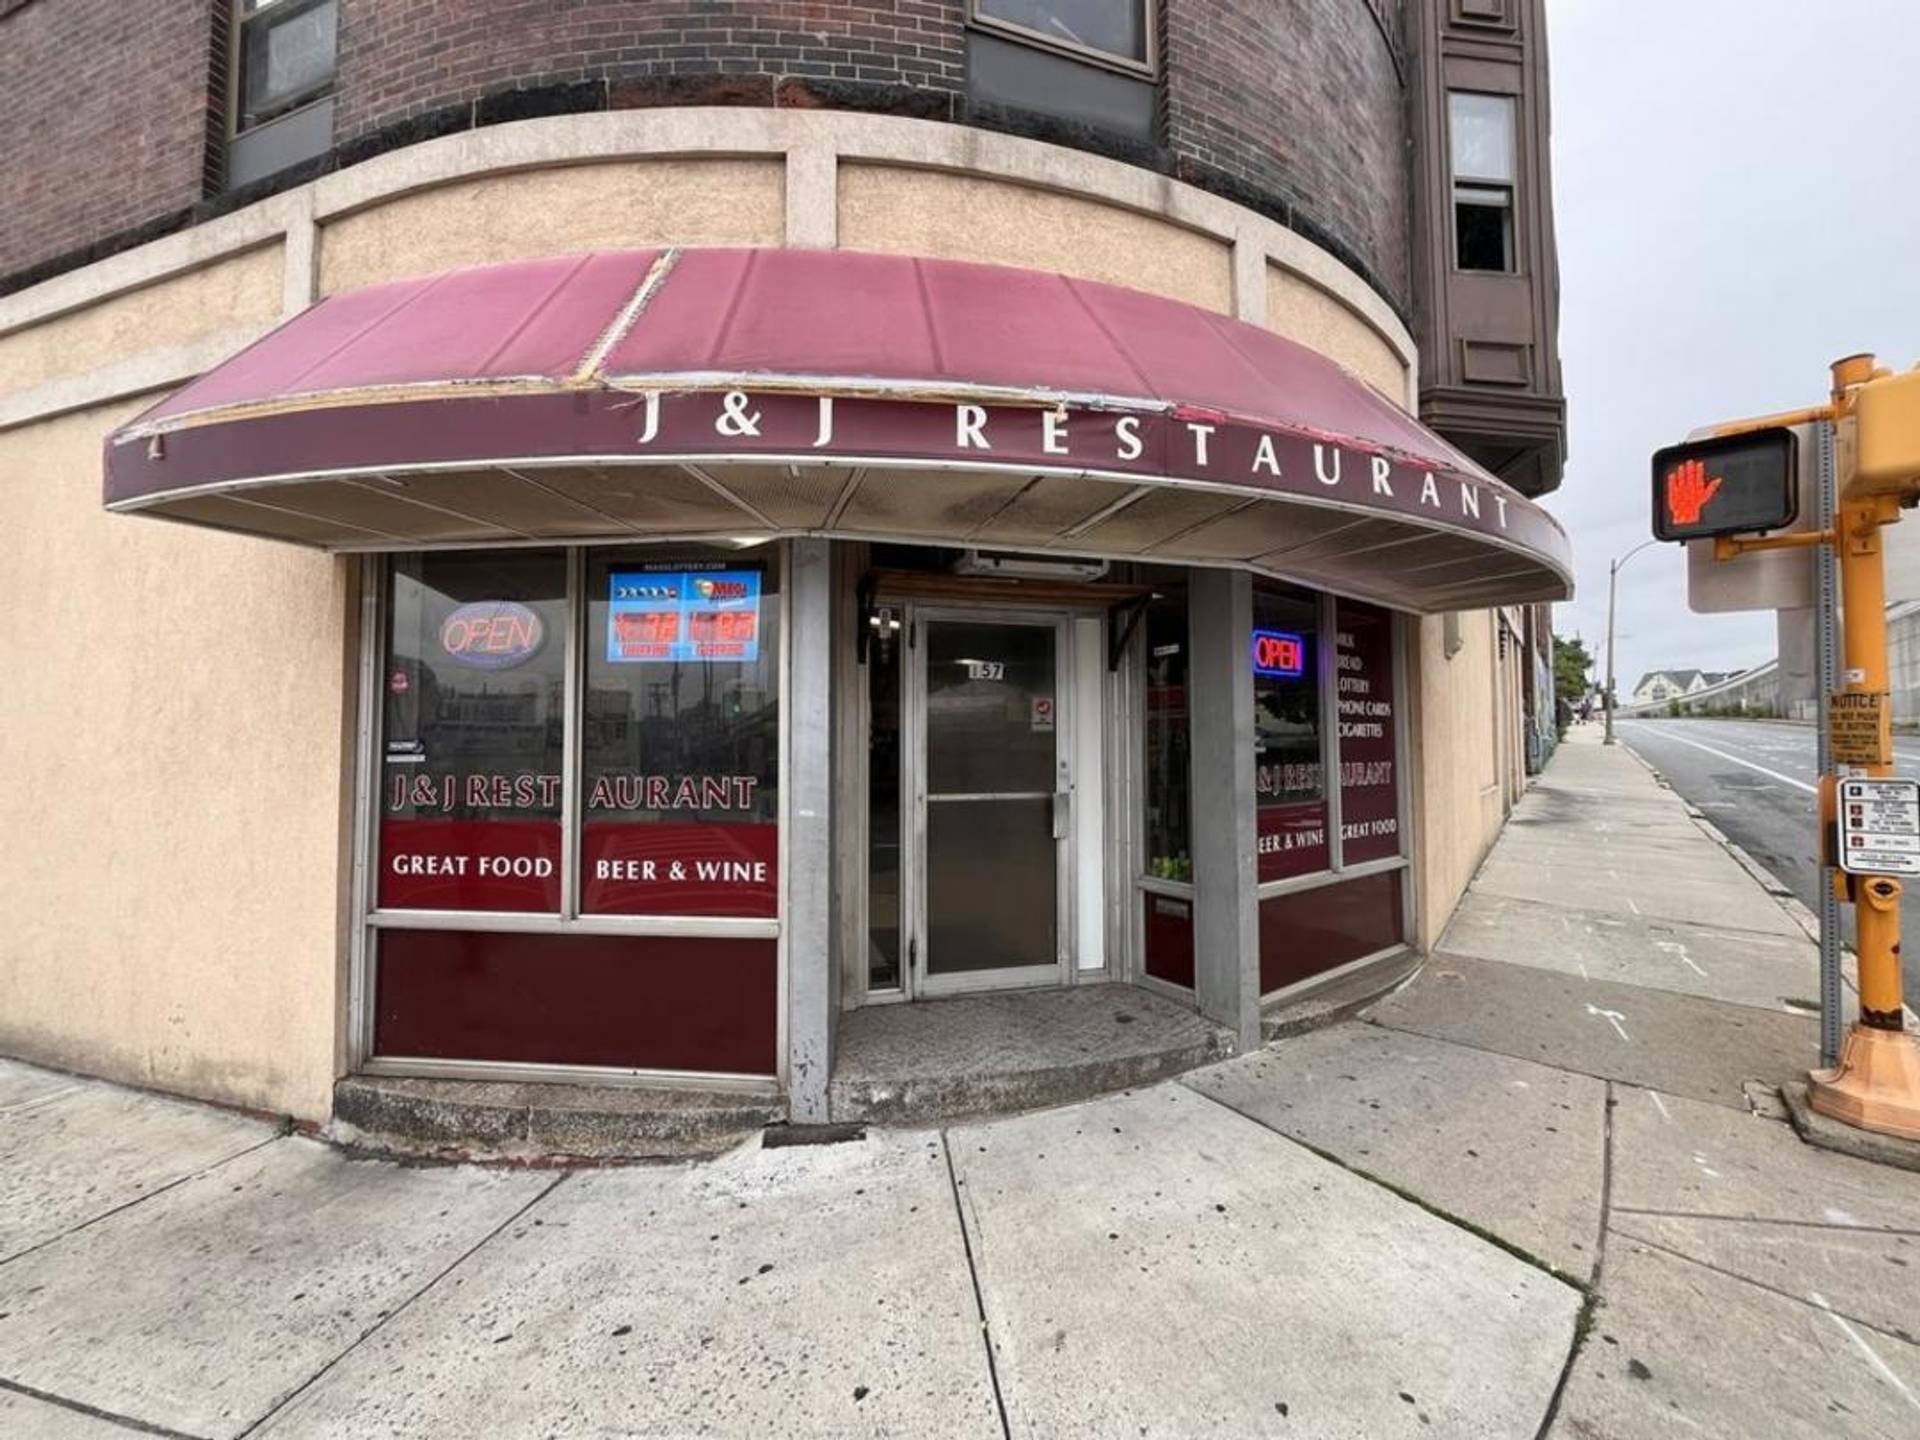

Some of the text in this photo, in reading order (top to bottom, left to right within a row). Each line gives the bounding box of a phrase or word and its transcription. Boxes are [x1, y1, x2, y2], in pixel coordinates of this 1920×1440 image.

[955, 404, 1508, 528] RESTAURANT
[443, 616, 535, 656] OPEN
[1256, 636, 1302, 671] OPEN
[1338, 655, 1363, 671] READ
[1339, 677, 1370, 693] OTTERY
[1366, 701, 1392, 717] CARDS
[1831, 694, 1877, 709] NOTICE
[1340, 818, 1398, 840] GREAT FOOD
[1258, 829, 1325, 854] EER & WINE
[393, 854, 768, 882] GREAT FOOD BEER & WINE
